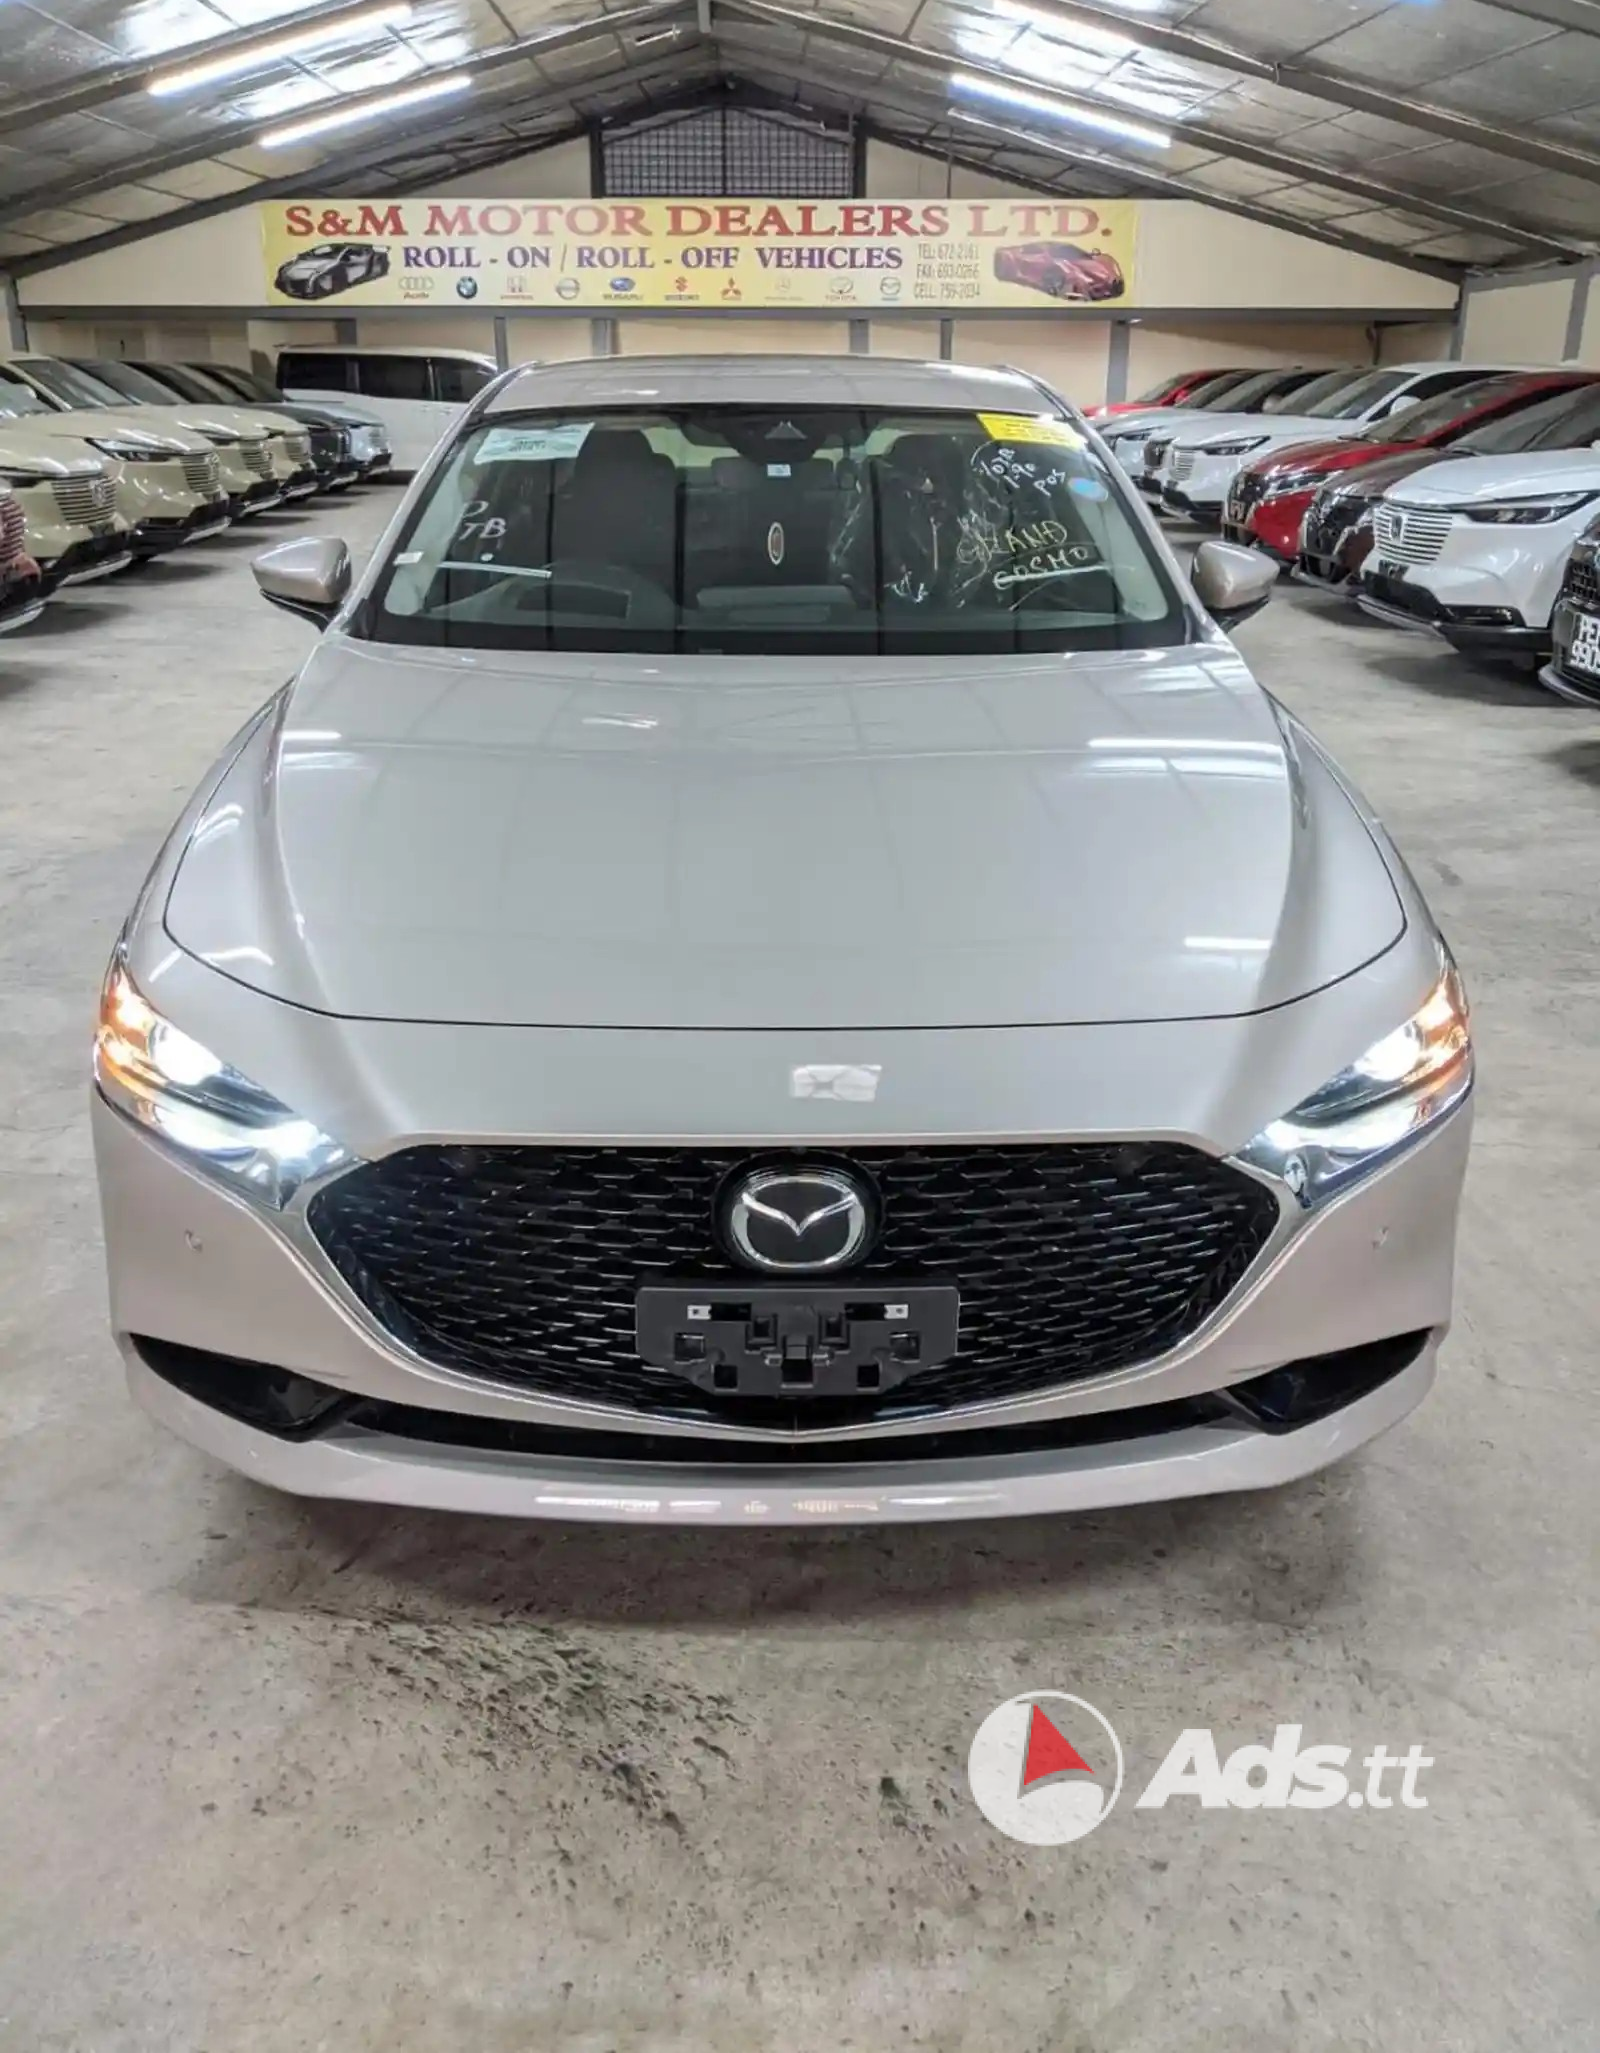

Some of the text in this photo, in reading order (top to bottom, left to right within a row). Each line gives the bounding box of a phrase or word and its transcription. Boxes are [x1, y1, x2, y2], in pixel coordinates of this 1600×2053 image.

[285, 205, 1112, 237] S&M MOTOR DEALERS LTD.
[403, 246, 481, 268] ROLL
[507, 246, 550, 268] ON
[577, 246, 655, 268] ROLL
[682, 246, 739, 268] OFF
[755, 246, 903, 269] VEHICLES
